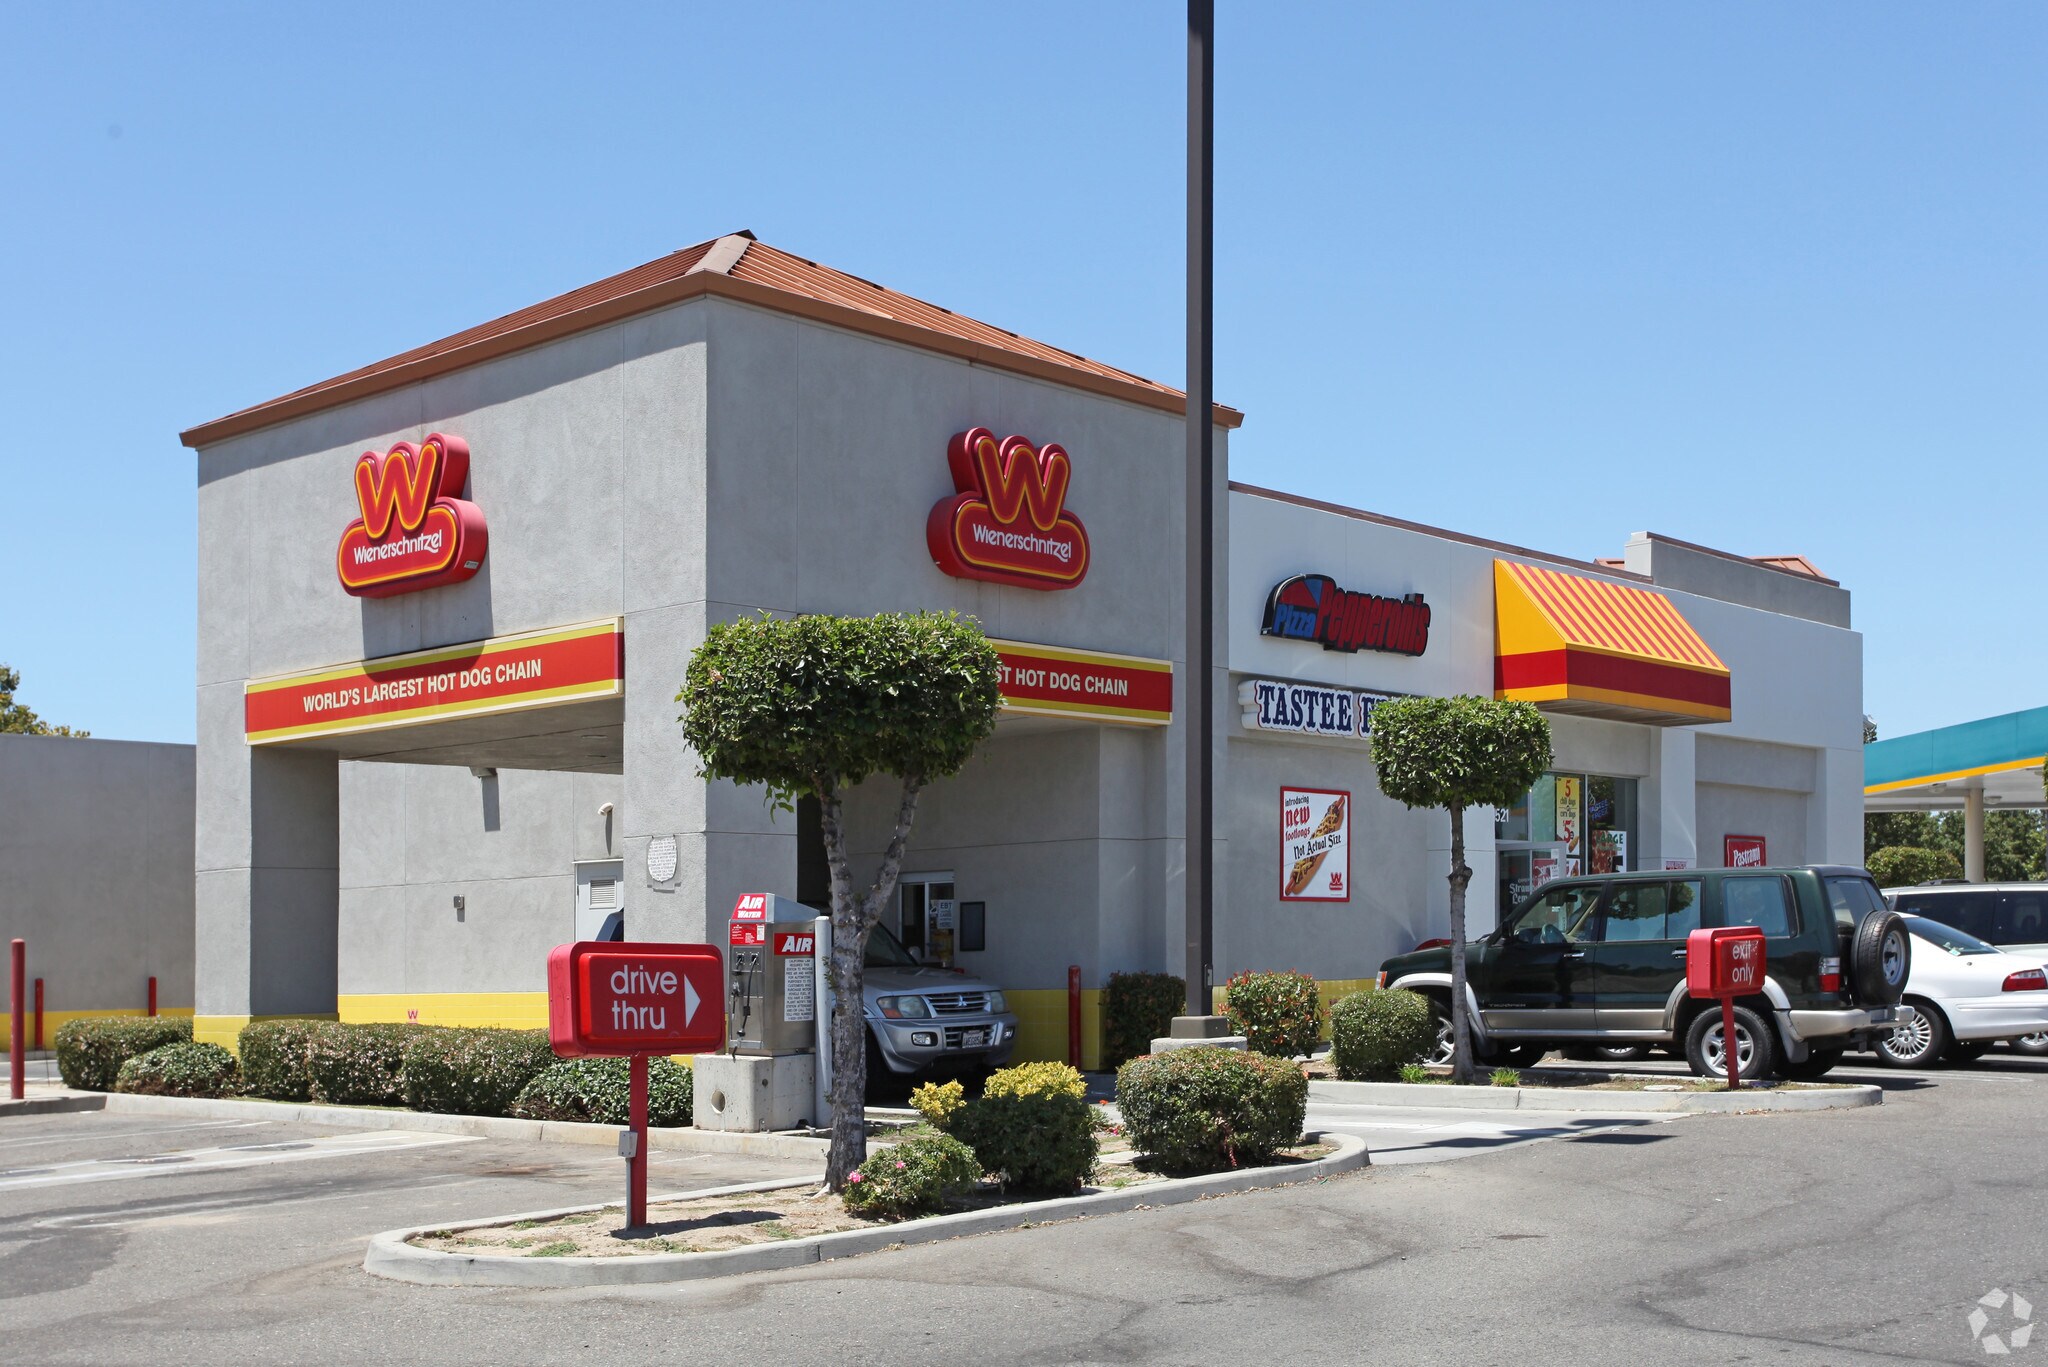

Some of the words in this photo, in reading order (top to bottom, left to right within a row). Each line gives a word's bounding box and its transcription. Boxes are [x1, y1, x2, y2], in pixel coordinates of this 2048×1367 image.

[355, 443, 437, 539] W
[978, 438, 1069, 532] W
[353, 528, 443, 565] Wienerschnitzel
[972, 523, 1072, 563] Wienerschnitzel
[303, 687, 360, 713] WORLD'S
[363, 677, 424, 704] LARGEST
[427, 672, 457, 694] HOT
[459, 666, 491, 689] DOG
[495, 658, 542, 683] CHAIN
[996, 665, 1012, 684] ST
[1015, 667, 1046, 688] HOT
[1049, 671, 1081, 692] DOG
[1084, 675, 1128, 696] CHAIN
[1258, 684, 1354, 732] TASTEE
[1285, 795, 1309, 807] introducing
[1565, 779, 1571, 797] 5
[1285, 805, 1310, 827] new
[1285, 826, 1310, 842] footlongs
[1293, 845, 1305, 860] Not
[1306, 837, 1327, 856] Actual
[1328, 834, 1341, 848] Size
[737, 910, 762, 918] WATER
[738, 895, 764, 909] AIR
[781, 935, 813, 953] AIR
[1732, 940, 1751, 960] exit
[610, 964, 678, 995] drive
[1732, 962, 1754, 985] only
[611, 1000, 666, 1030] thru
